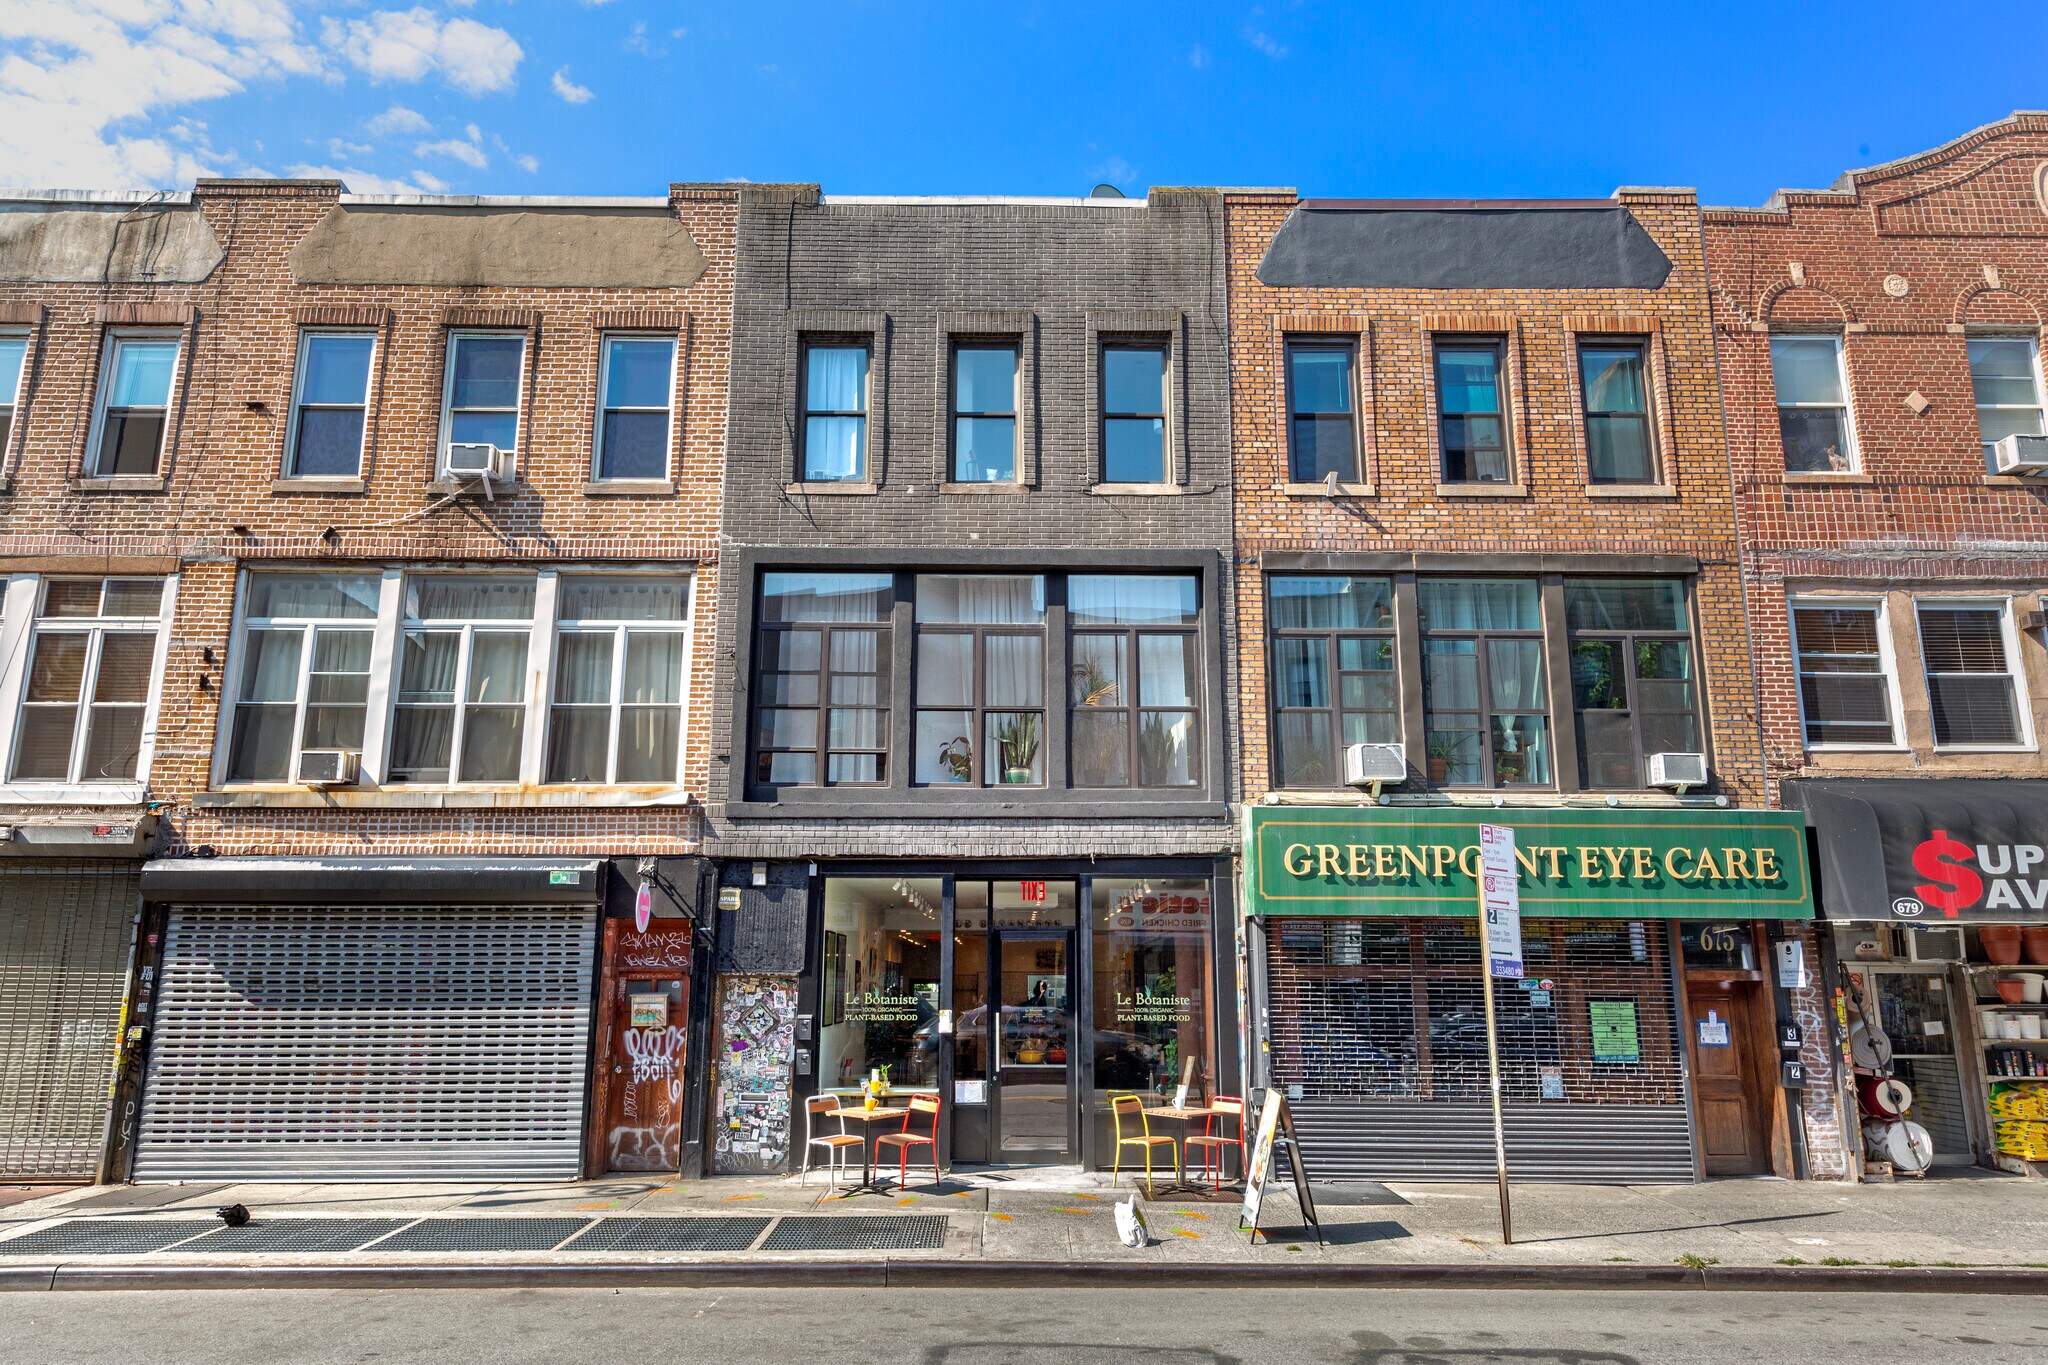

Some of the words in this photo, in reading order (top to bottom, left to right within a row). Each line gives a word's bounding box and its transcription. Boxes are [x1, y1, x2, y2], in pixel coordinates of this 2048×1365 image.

[1284, 843, 1568, 879] GREENPONT
[1576, 846, 1657, 880] EYE
[1664, 846, 1780, 880] CARE
[1896, 903, 1919, 914] 679
[1489, 910, 1496, 923] 2
[1701, 926, 1735, 951] 675
[1496, 965, 1515, 976] 333480
[845, 992, 860, 1005] Le
[864, 992, 919, 1005] Botaniste
[1117, 992, 1132, 1005] Le
[1135, 992, 1190, 1006] Botaniste
[1168, 1014, 1191, 1022] FOOD
[1788, 1028, 1795, 1039] 3
[1792, 1067, 1799, 1078] 2
